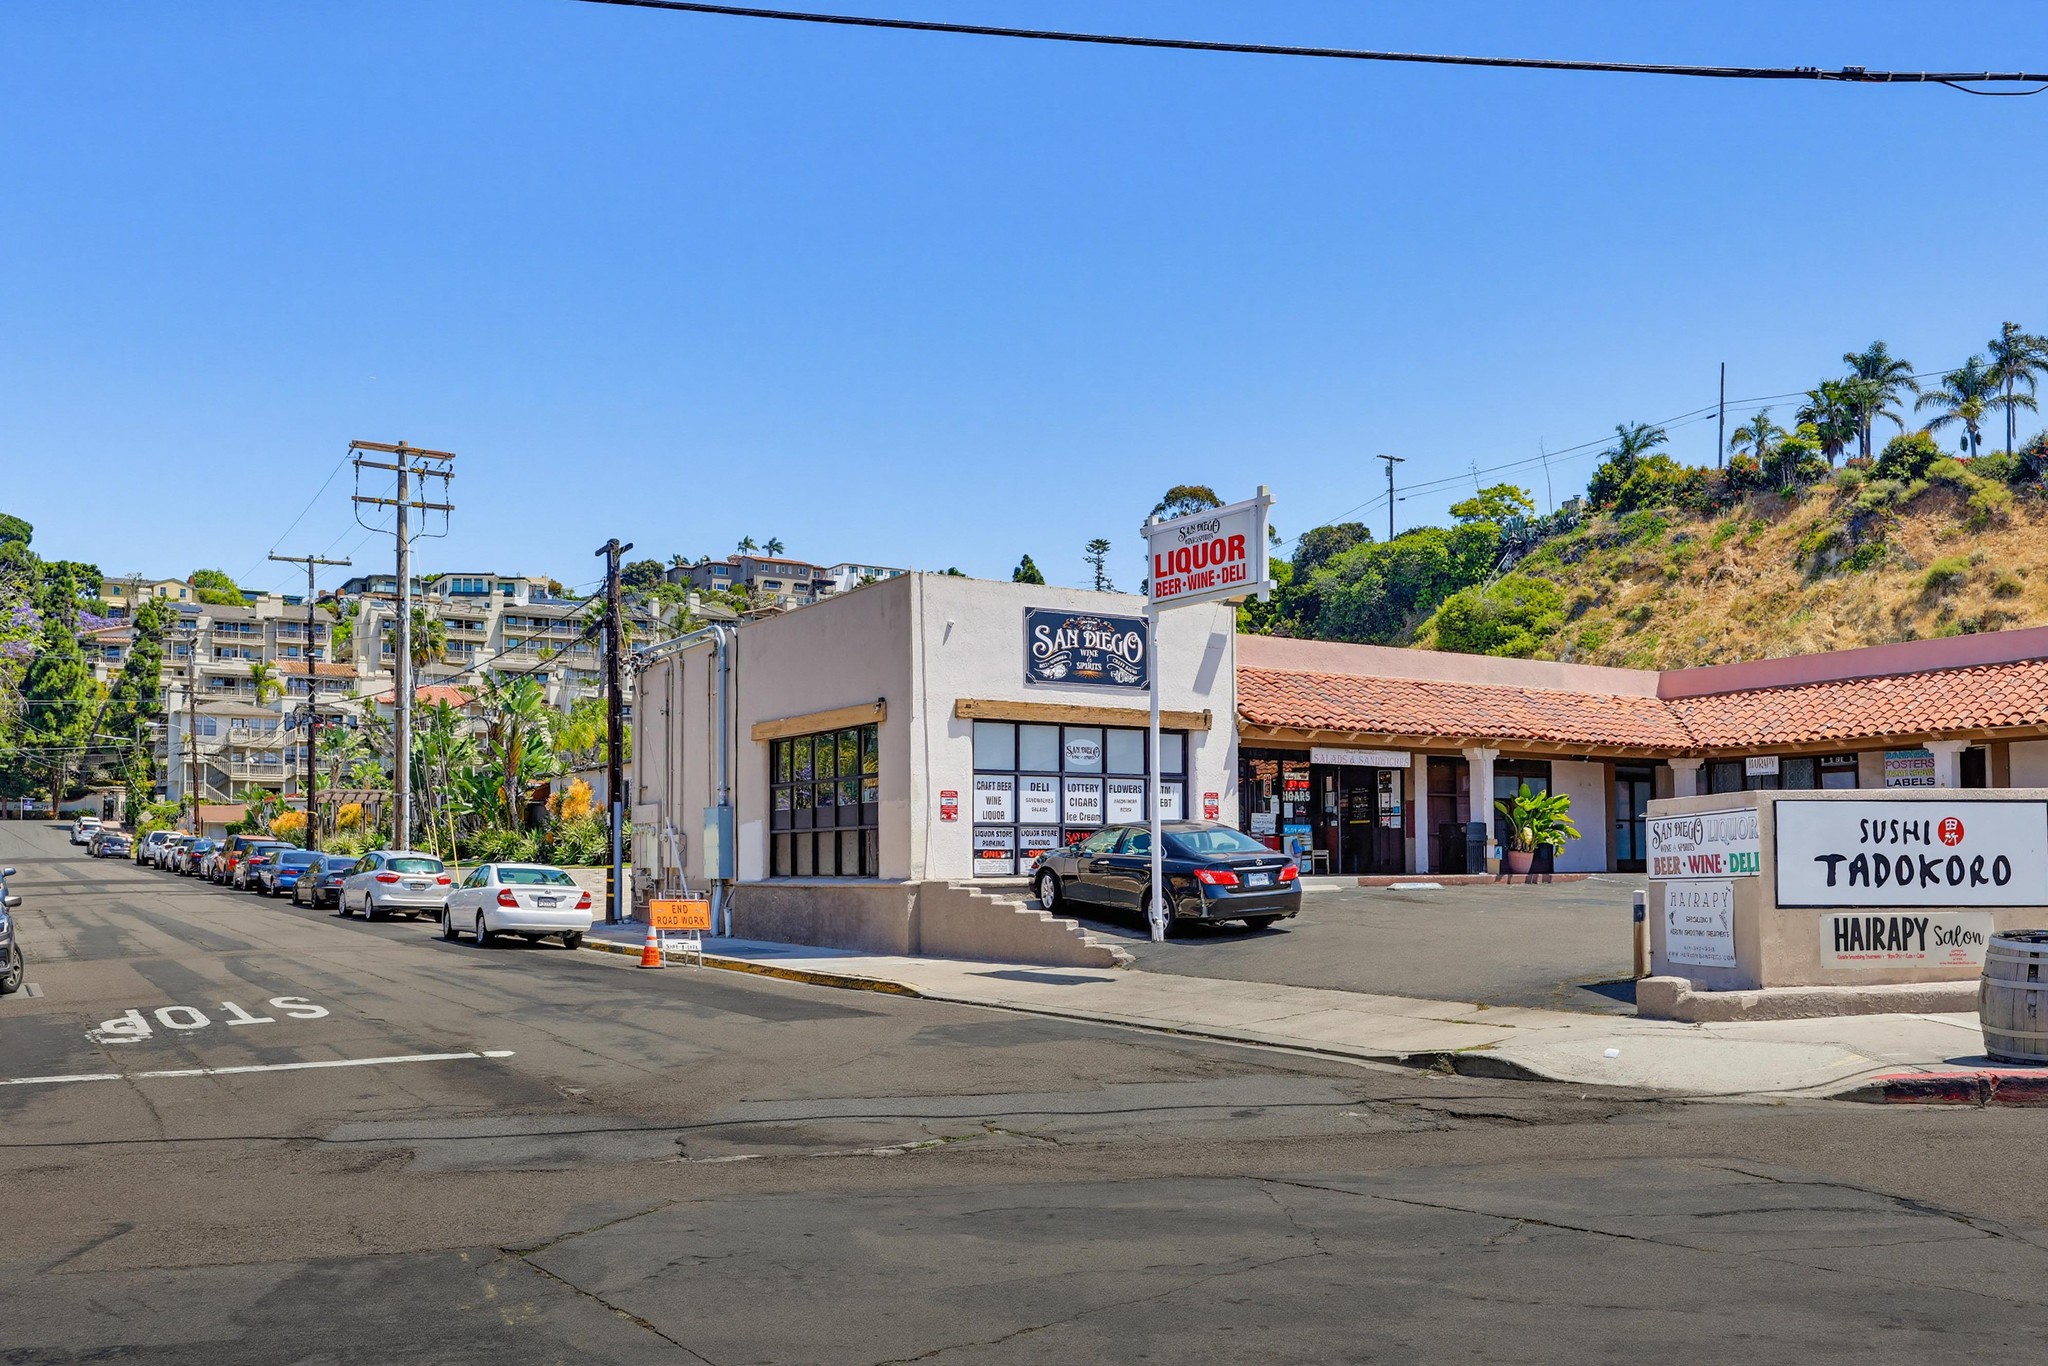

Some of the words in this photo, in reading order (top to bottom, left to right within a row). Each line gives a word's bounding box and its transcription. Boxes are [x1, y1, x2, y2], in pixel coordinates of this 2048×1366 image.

[1178, 524, 1196, 542] SAN
[1197, 518, 1221, 534] DIEGO
[1155, 534, 1246, 579] LIQUOR
[1156, 578, 1182, 598] BEER
[1187, 570, 1215, 591] WINE
[1222, 563, 1246, 584] DELI
[1033, 625, 1079, 658] SAN
[1083, 630, 1143, 663] DIEGO
[1080, 649, 1099, 658] WINE
[1076, 662, 1103, 671] SPIRITS
[1314, 754, 1347, 764] SALADS
[1358, 756, 1409, 767] SANDWICHES
[1885, 758, 1935, 769] POSTERS
[976, 781, 996, 791] CRAFT
[997, 781, 1012, 791] BEER
[1030, 783, 1049, 791] DELI
[1886, 777, 1935, 787] LABELS
[1067, 784, 1099, 793] LOTTERY
[1109, 785, 1142, 794] FLOWERS
[1159, 786, 1171, 794] TM
[986, 796, 1002, 805] WINE
[1070, 798, 1098, 807] CIGARS
[1160, 799, 1172, 807] EBT
[983, 811, 1005, 820] LIQUOR
[1066, 812, 1077, 821] Ice
[1079, 812, 1100, 821] Cream
[1652, 822, 1673, 850] SAN
[1674, 818, 1703, 845] DIEGO
[1707, 815, 1759, 846] LIQUOR
[1860, 818, 1931, 845] SUSHI
[983, 850, 1006, 858] ONLY
[1653, 856, 1681, 875] BEER
[1687, 854, 1722, 874] WINE
[1729, 852, 1760, 873] DELI
[1814, 853, 2012, 888] TADOKORO
[1670, 892, 1728, 908] HAIRAPY
[671, 905, 688, 914] END
[657, 917, 678, 925] ROAD
[682, 917, 704, 925] WORK
[1834, 917, 1929, 952] HAIRAPY
[1933, 925, 1985, 947] Salon
[85, 996, 330, 1044] STOP
